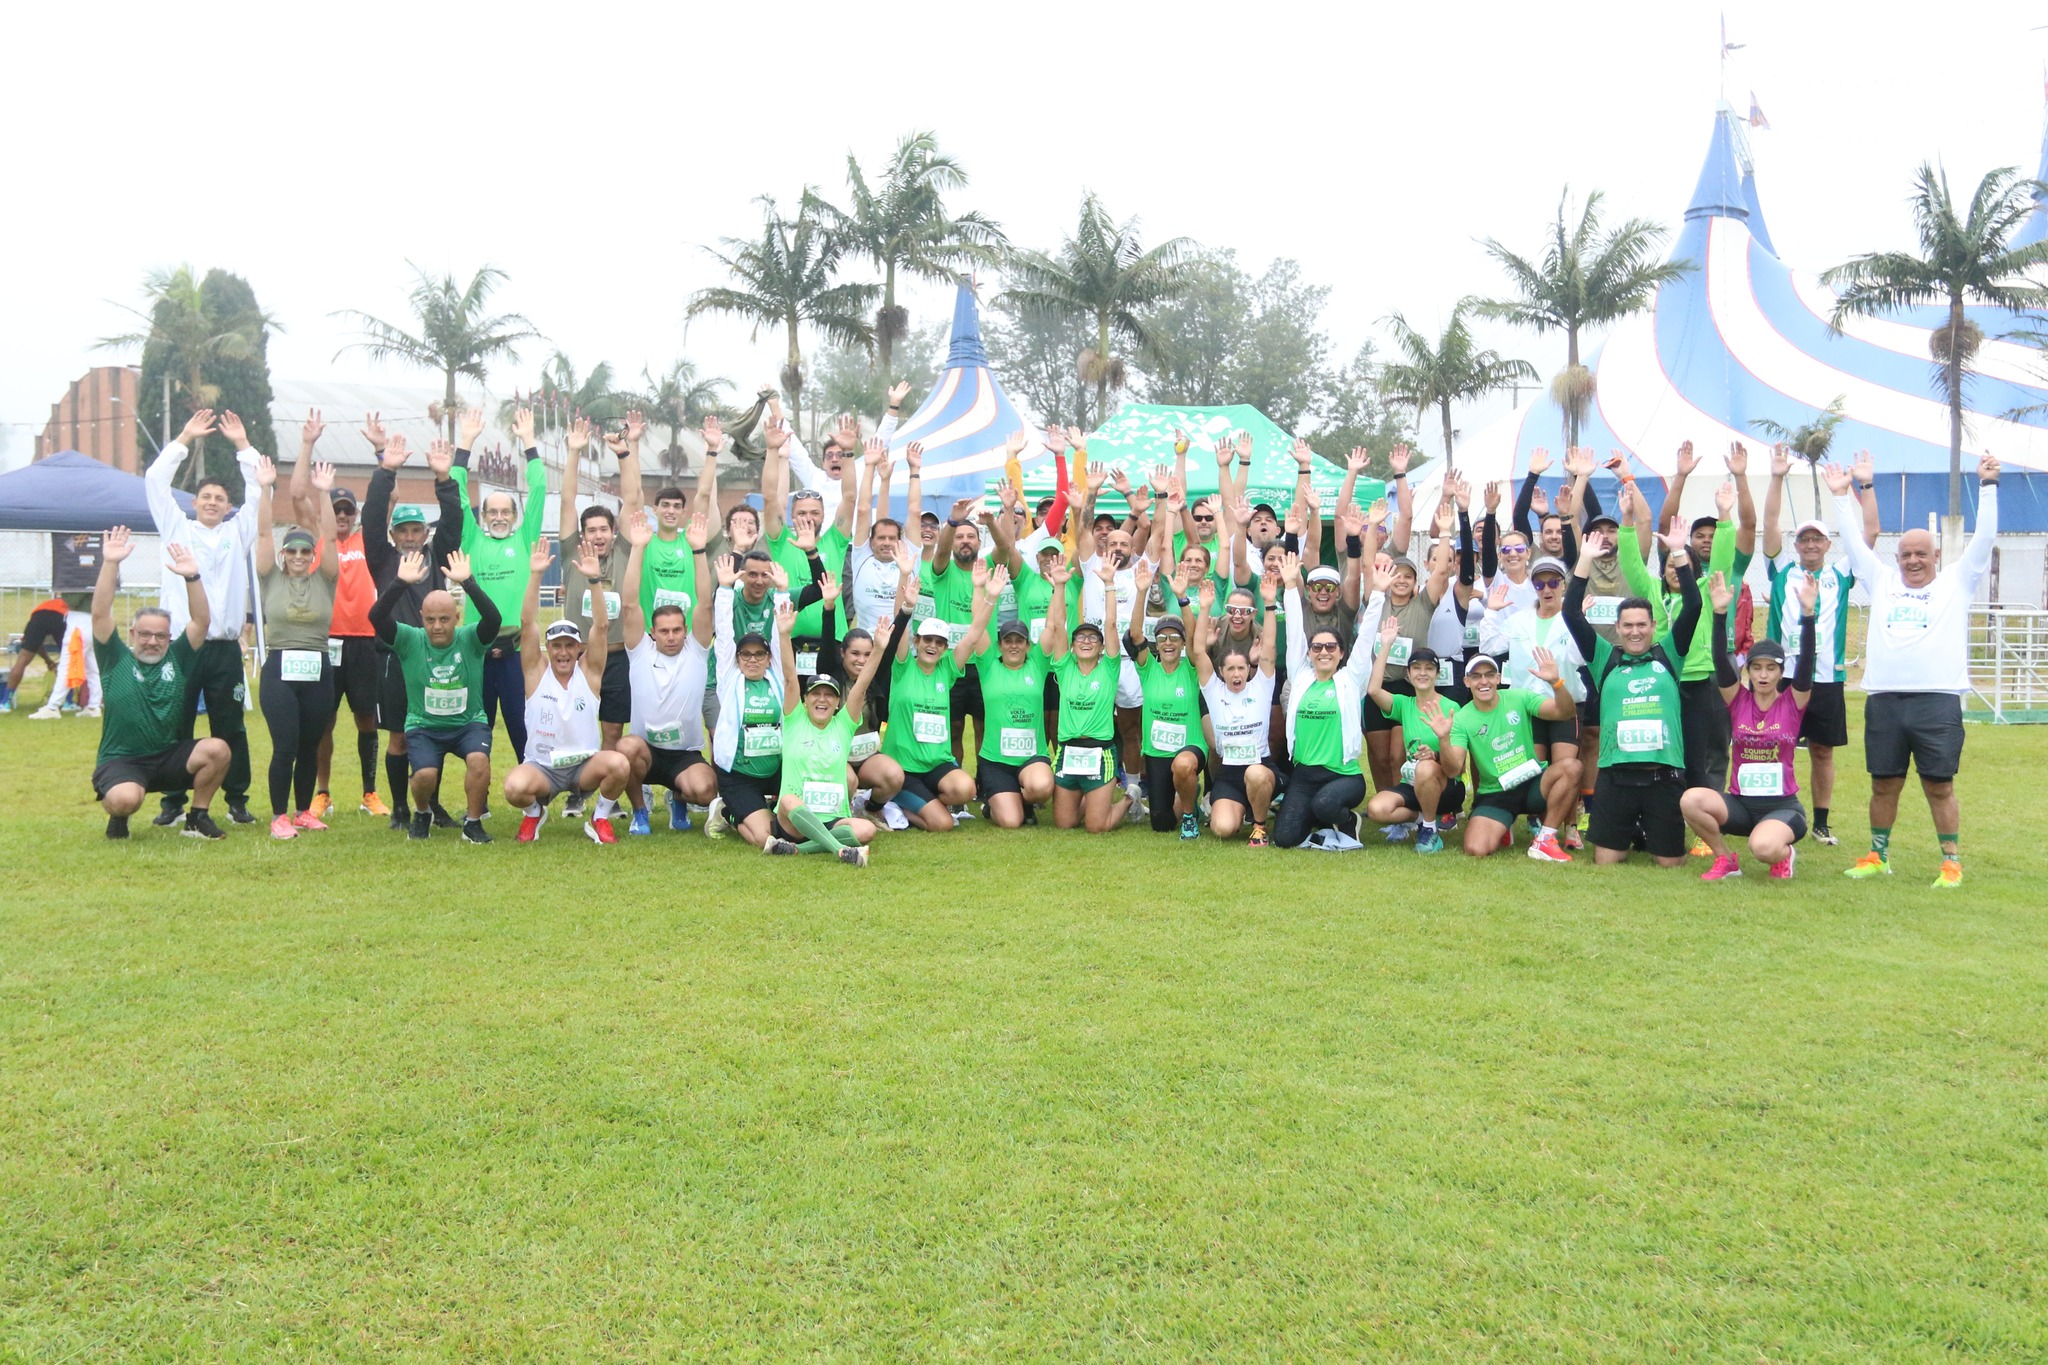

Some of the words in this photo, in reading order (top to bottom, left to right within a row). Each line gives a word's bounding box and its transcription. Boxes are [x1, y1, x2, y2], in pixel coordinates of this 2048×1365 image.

[1591, 605, 1616, 617] 698
[1889, 607, 1926, 620] 1540
[285, 661, 319, 673] 1990
[430, 697, 458, 708] 164
[918, 722, 942, 735] 459
[654, 731, 671, 742] 43
[1153, 730, 1183, 744] 1464
[1623, 731, 1653, 743] 818
[748, 737, 778, 749] 1746
[1003, 738, 1032, 749] 1500
[1225, 747, 1254, 758] 1394
[1740, 753, 1772, 761] CORRIDA
[1073, 755, 1089, 768] 66
[1743, 774, 1772, 787] 759
[805, 791, 838, 805] 1348
